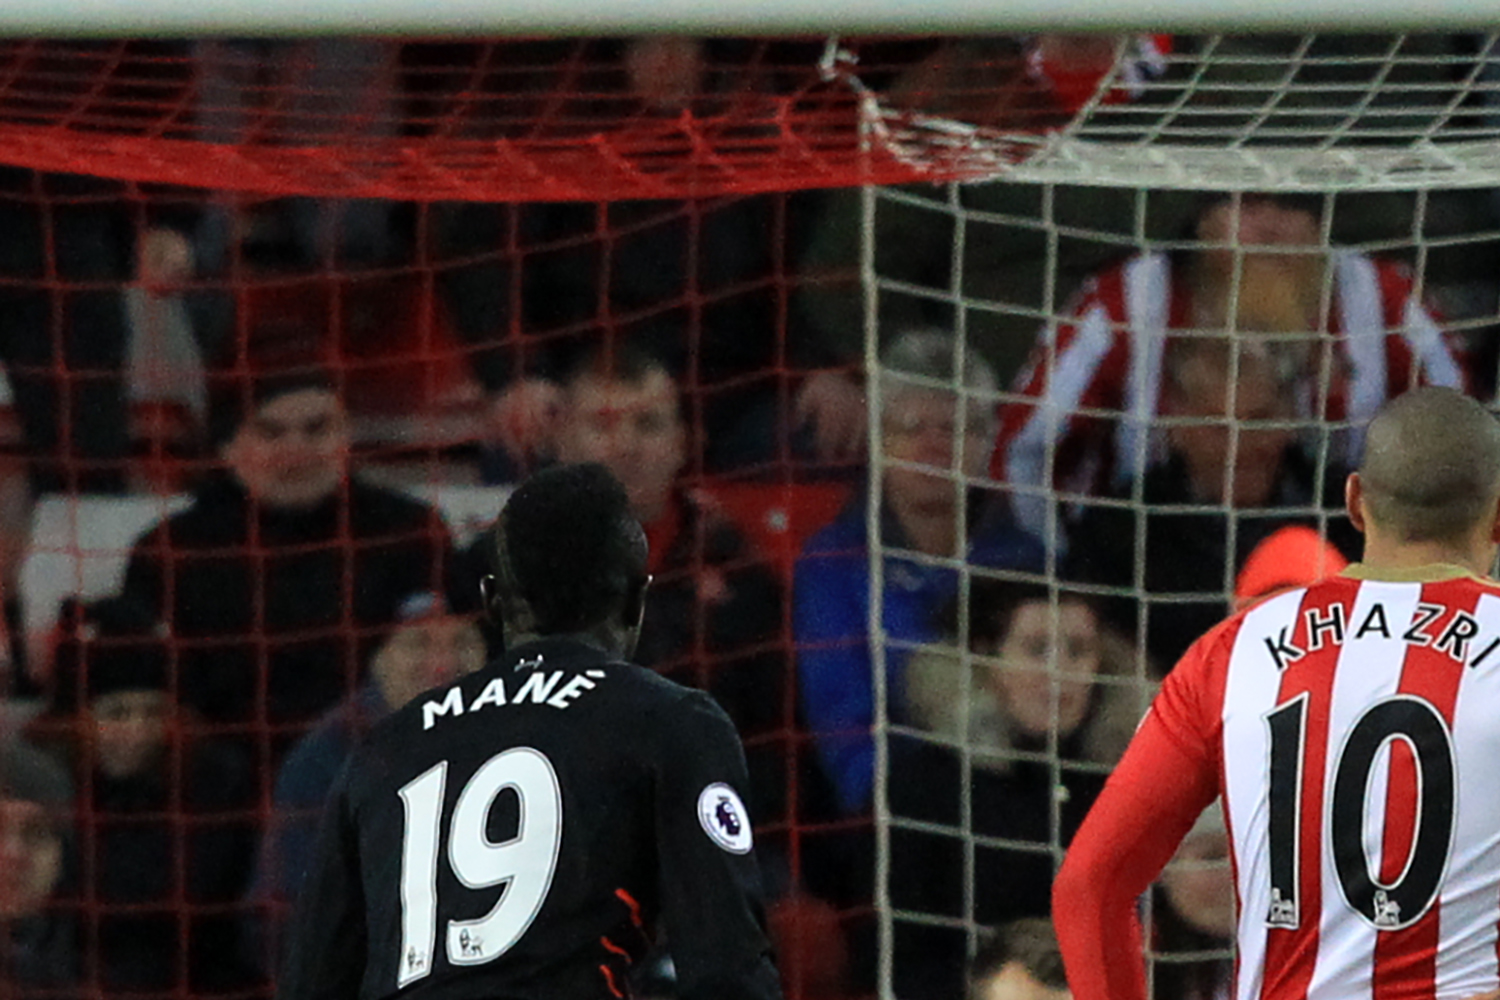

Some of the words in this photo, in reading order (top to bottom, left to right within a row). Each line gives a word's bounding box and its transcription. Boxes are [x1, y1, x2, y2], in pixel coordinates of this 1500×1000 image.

[421, 670, 607, 731] MANÉ
[1260, 690, 1460, 932] 10
[397, 746, 563, 989] 19
